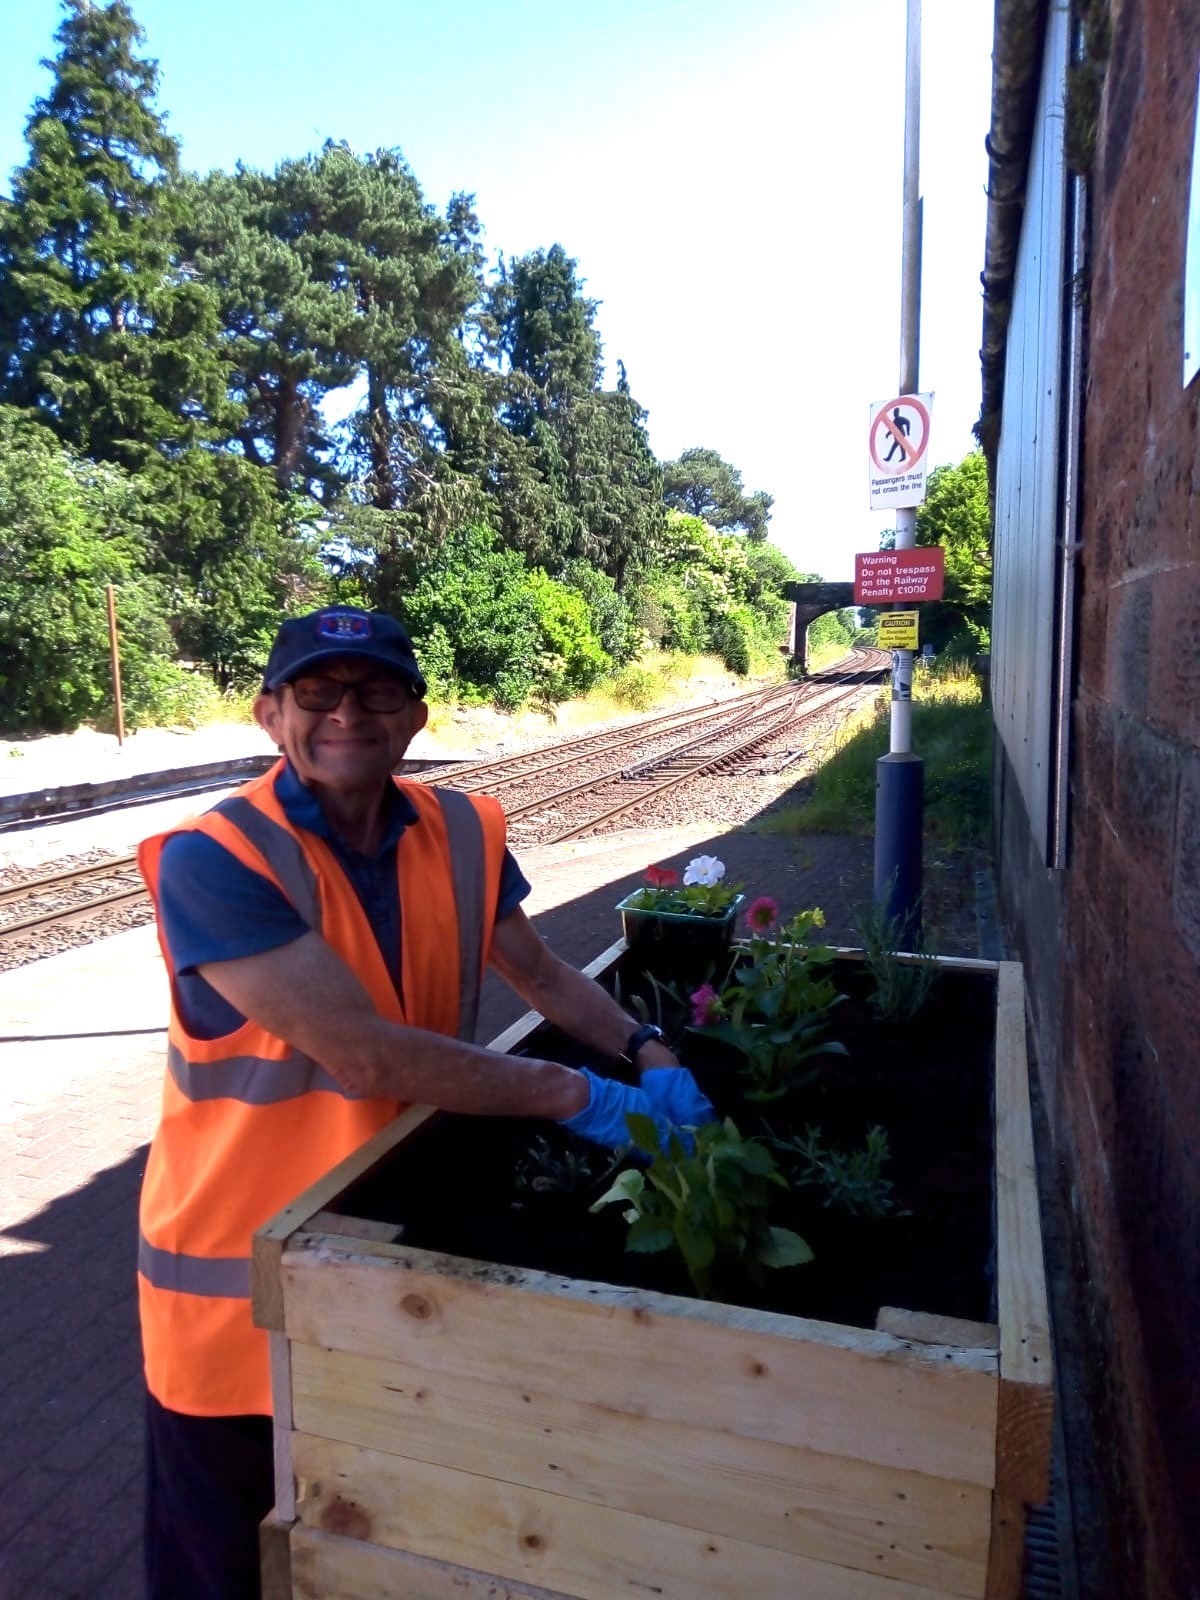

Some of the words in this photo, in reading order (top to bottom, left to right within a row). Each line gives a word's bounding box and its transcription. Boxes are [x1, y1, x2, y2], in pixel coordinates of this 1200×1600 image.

[907, 472, 922, 480] must
[862, 556, 897, 564] Warning
[896, 566, 936, 575] trespass
[894, 576, 928, 584] Railway
[862, 587, 893, 596] Penalty
[898, 585, 926, 594] £1000
